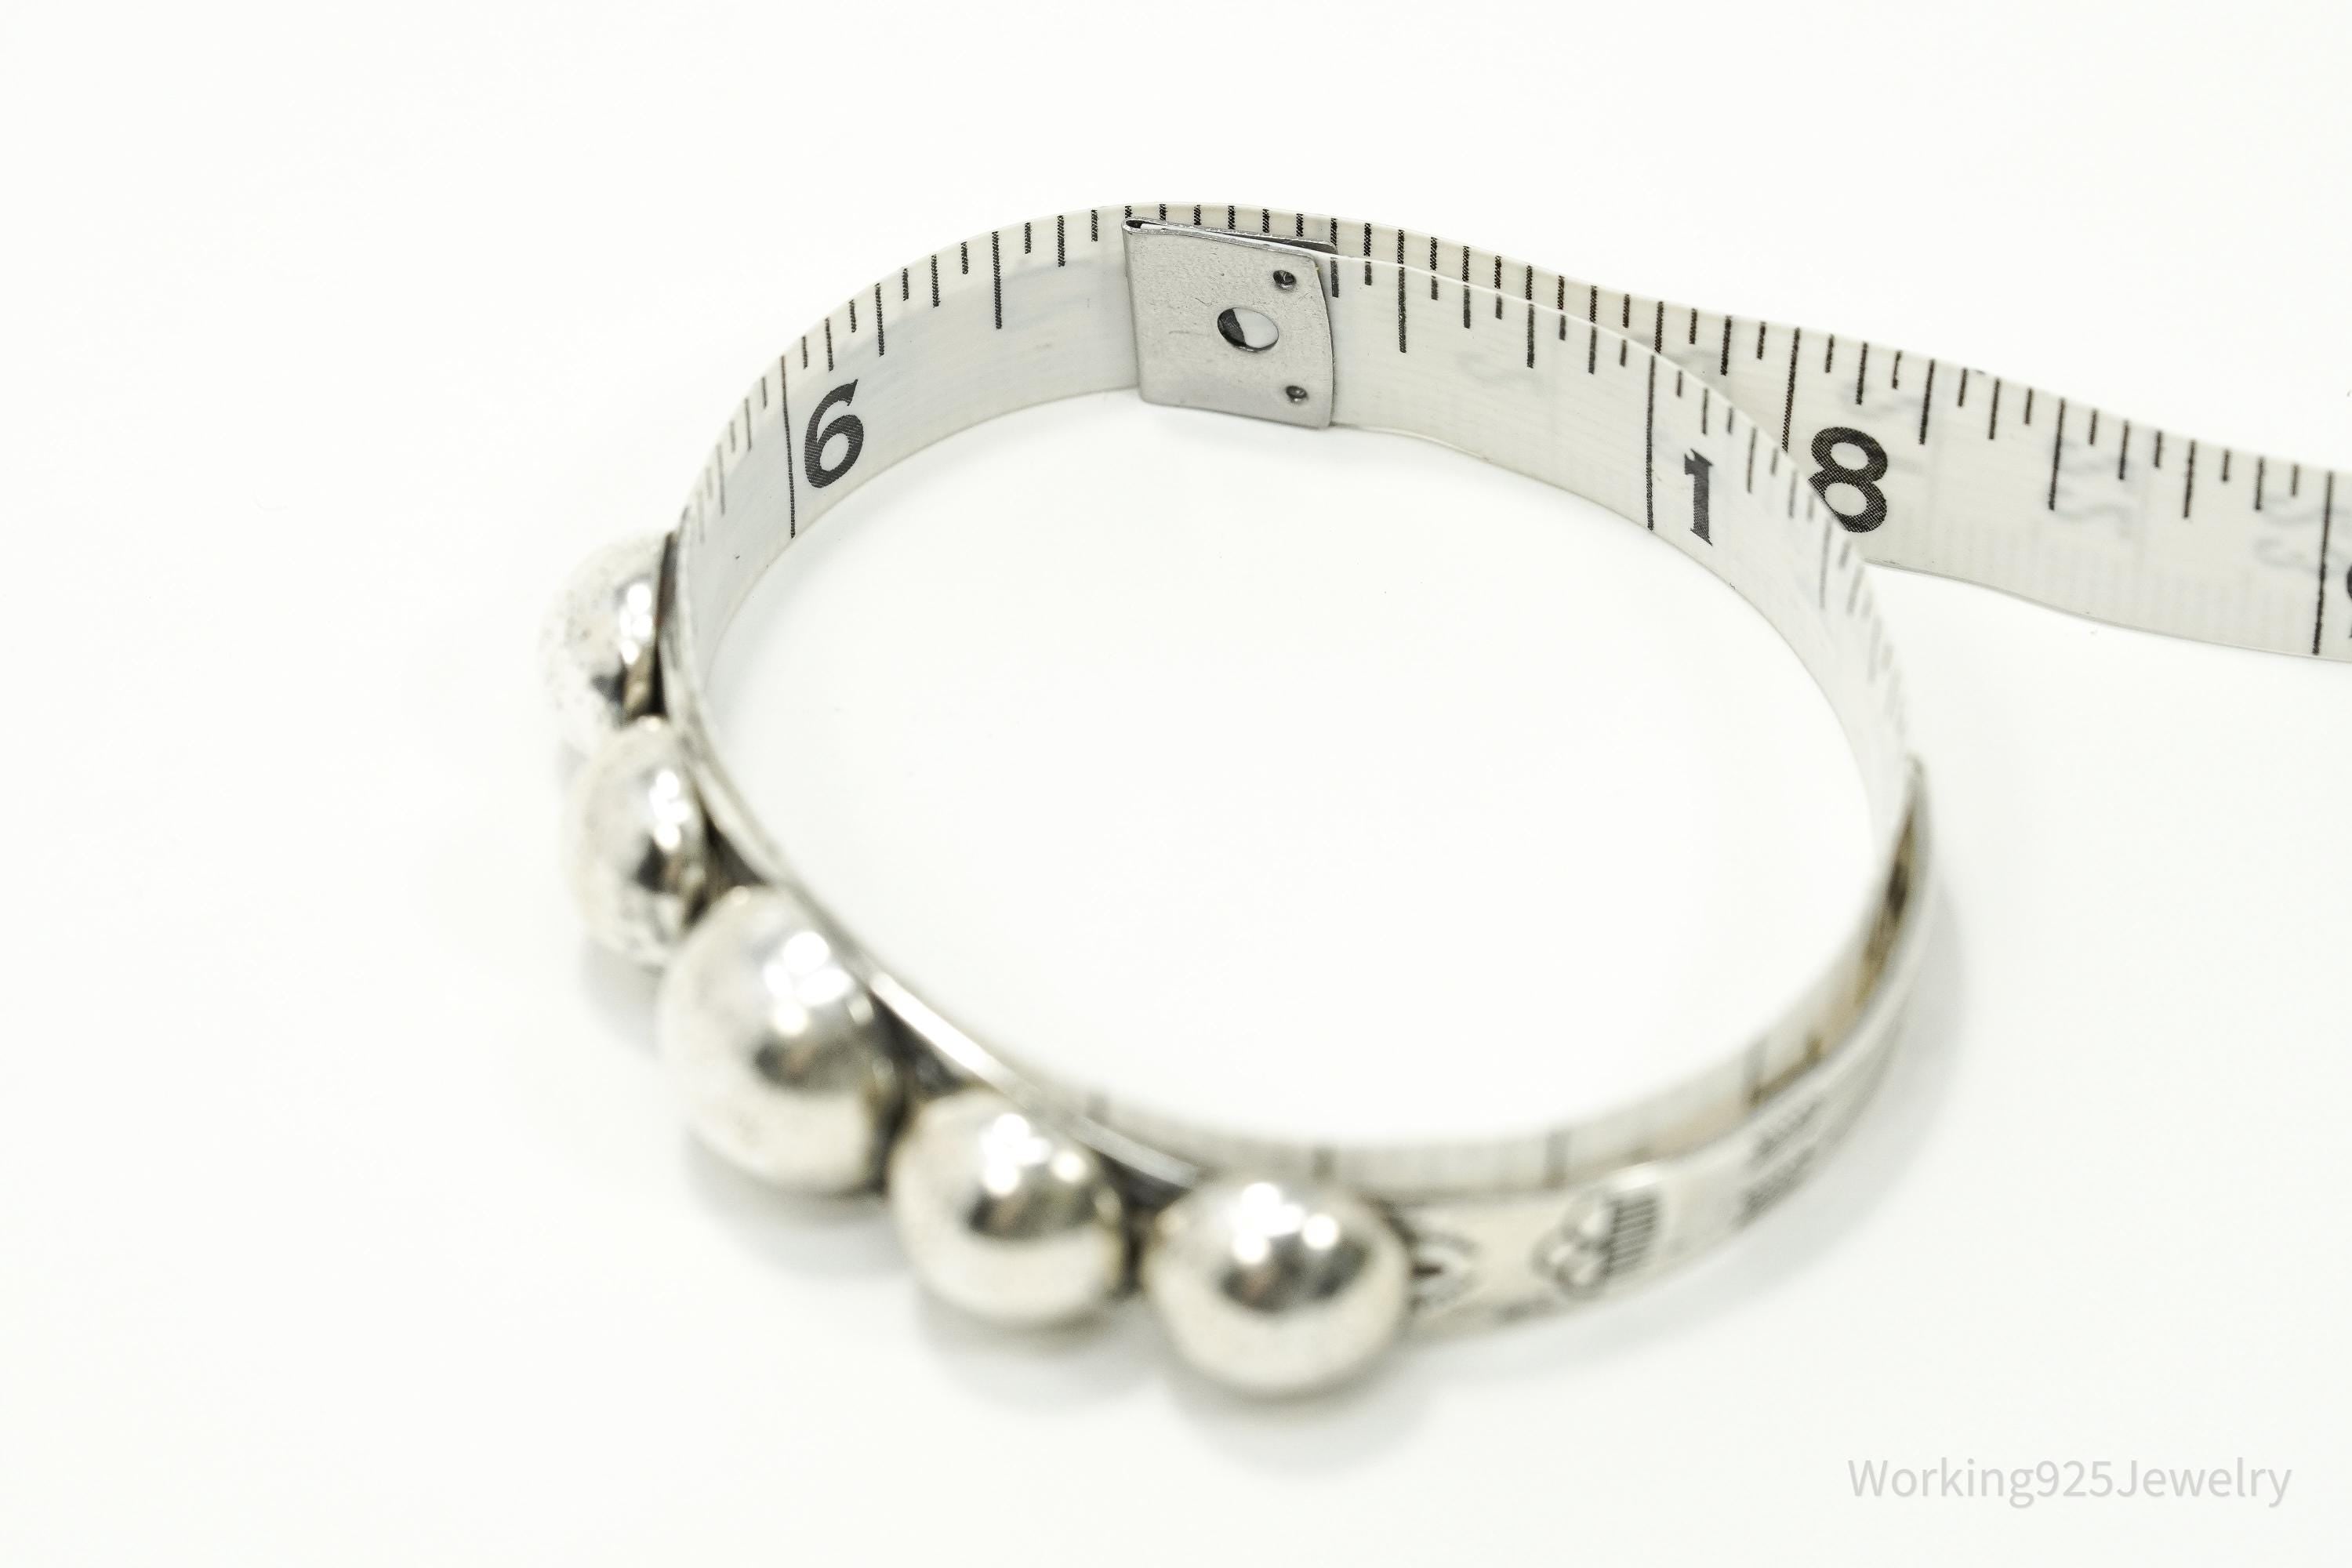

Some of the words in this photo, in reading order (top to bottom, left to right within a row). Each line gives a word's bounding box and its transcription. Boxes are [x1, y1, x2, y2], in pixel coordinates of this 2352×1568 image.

[804, 379, 865, 488] 6
[1808, 426, 1888, 533] 8
[1683, 448, 1714, 546] 1
